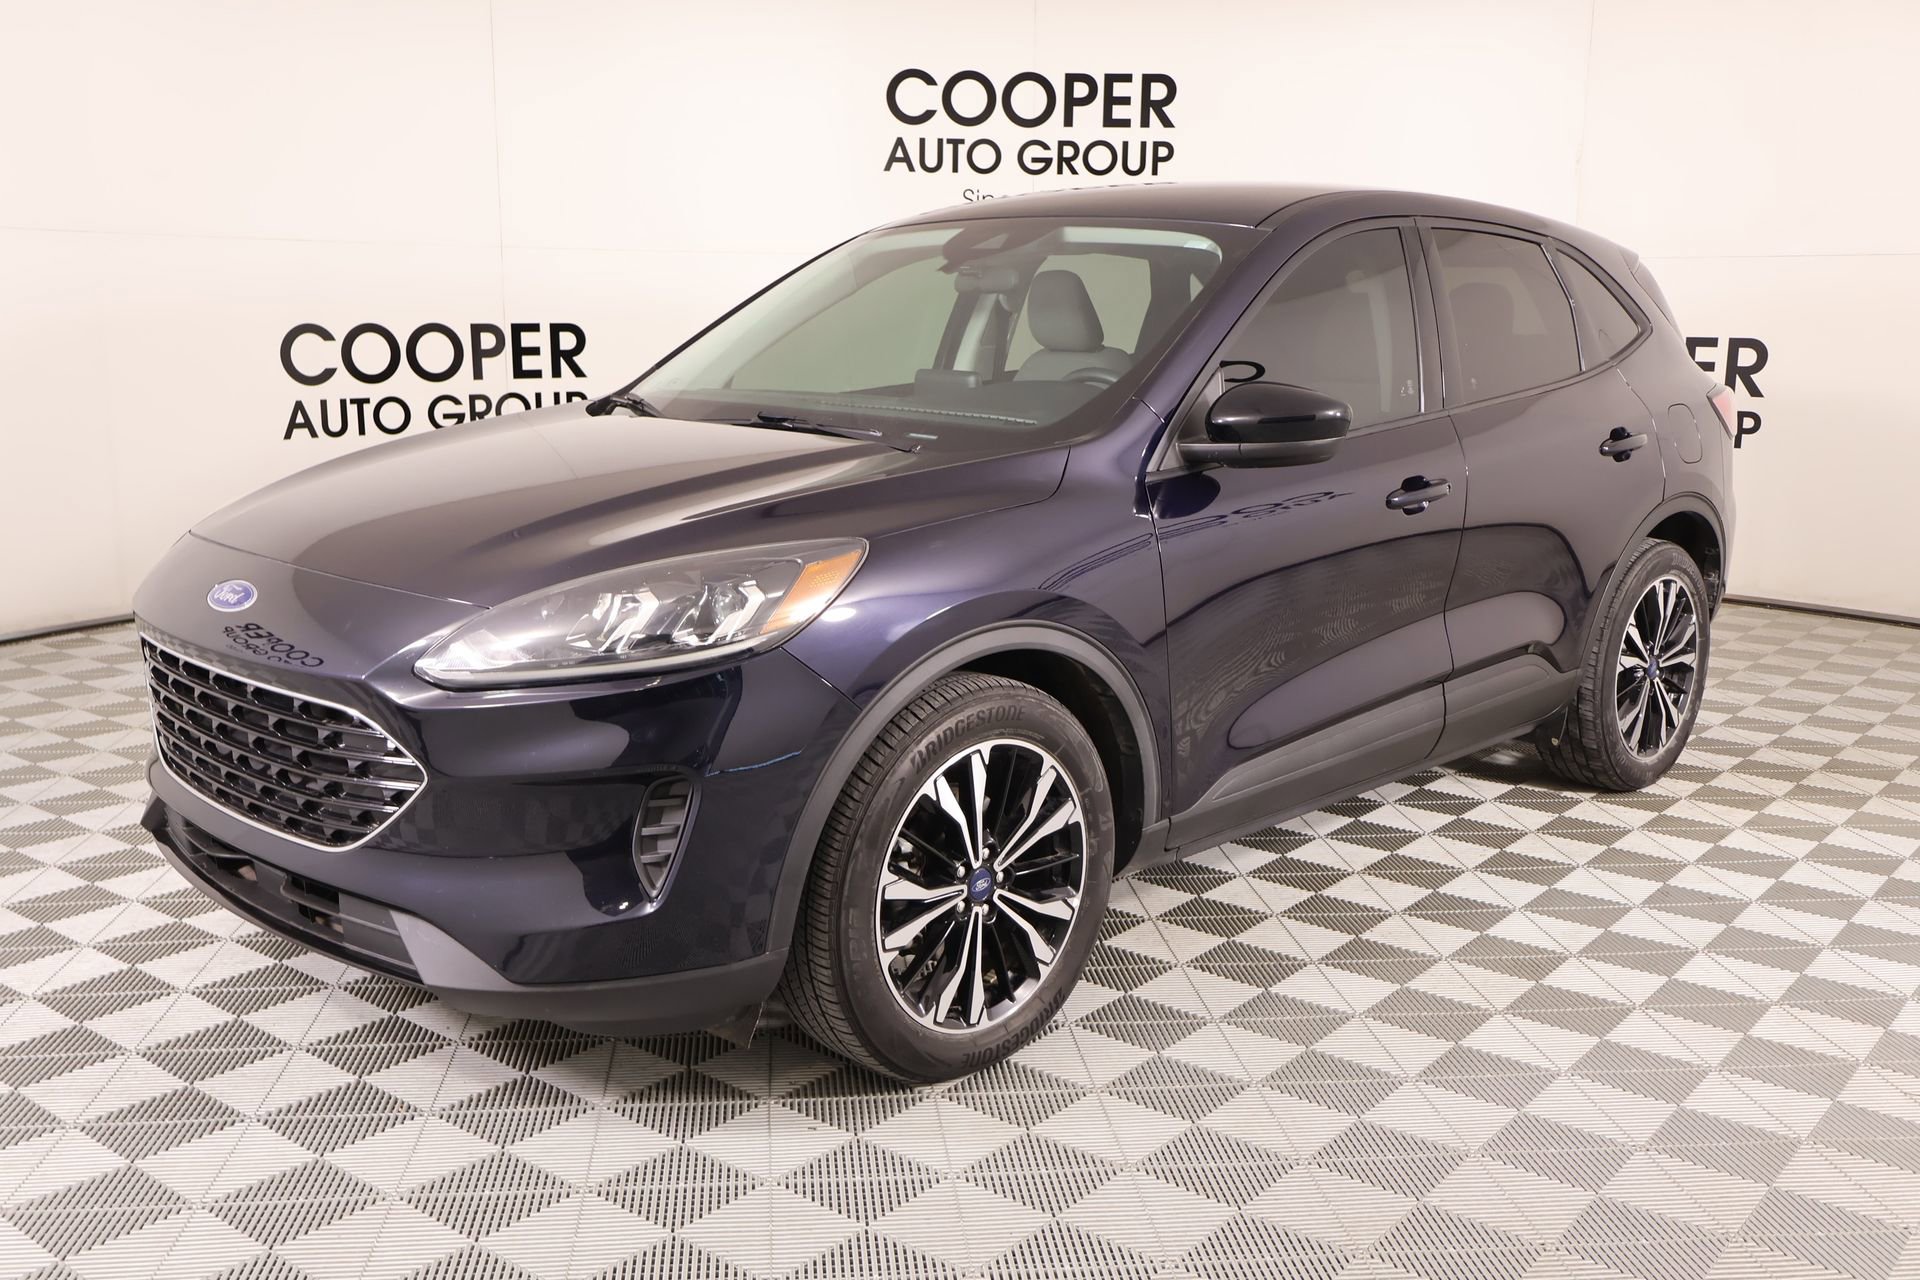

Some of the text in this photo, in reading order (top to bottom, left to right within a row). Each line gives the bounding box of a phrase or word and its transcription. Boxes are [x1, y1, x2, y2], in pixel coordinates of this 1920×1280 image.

[886, 68, 1178, 129] COOPER
[883, 136, 1175, 177] AUTO GROUP
[279, 322, 588, 387] COOPER
[283, 396, 412, 440] AUTO
[910, 704, 1026, 775] BRIDGESTONE
[961, 987, 1066, 1069] BRIDGESTONE
